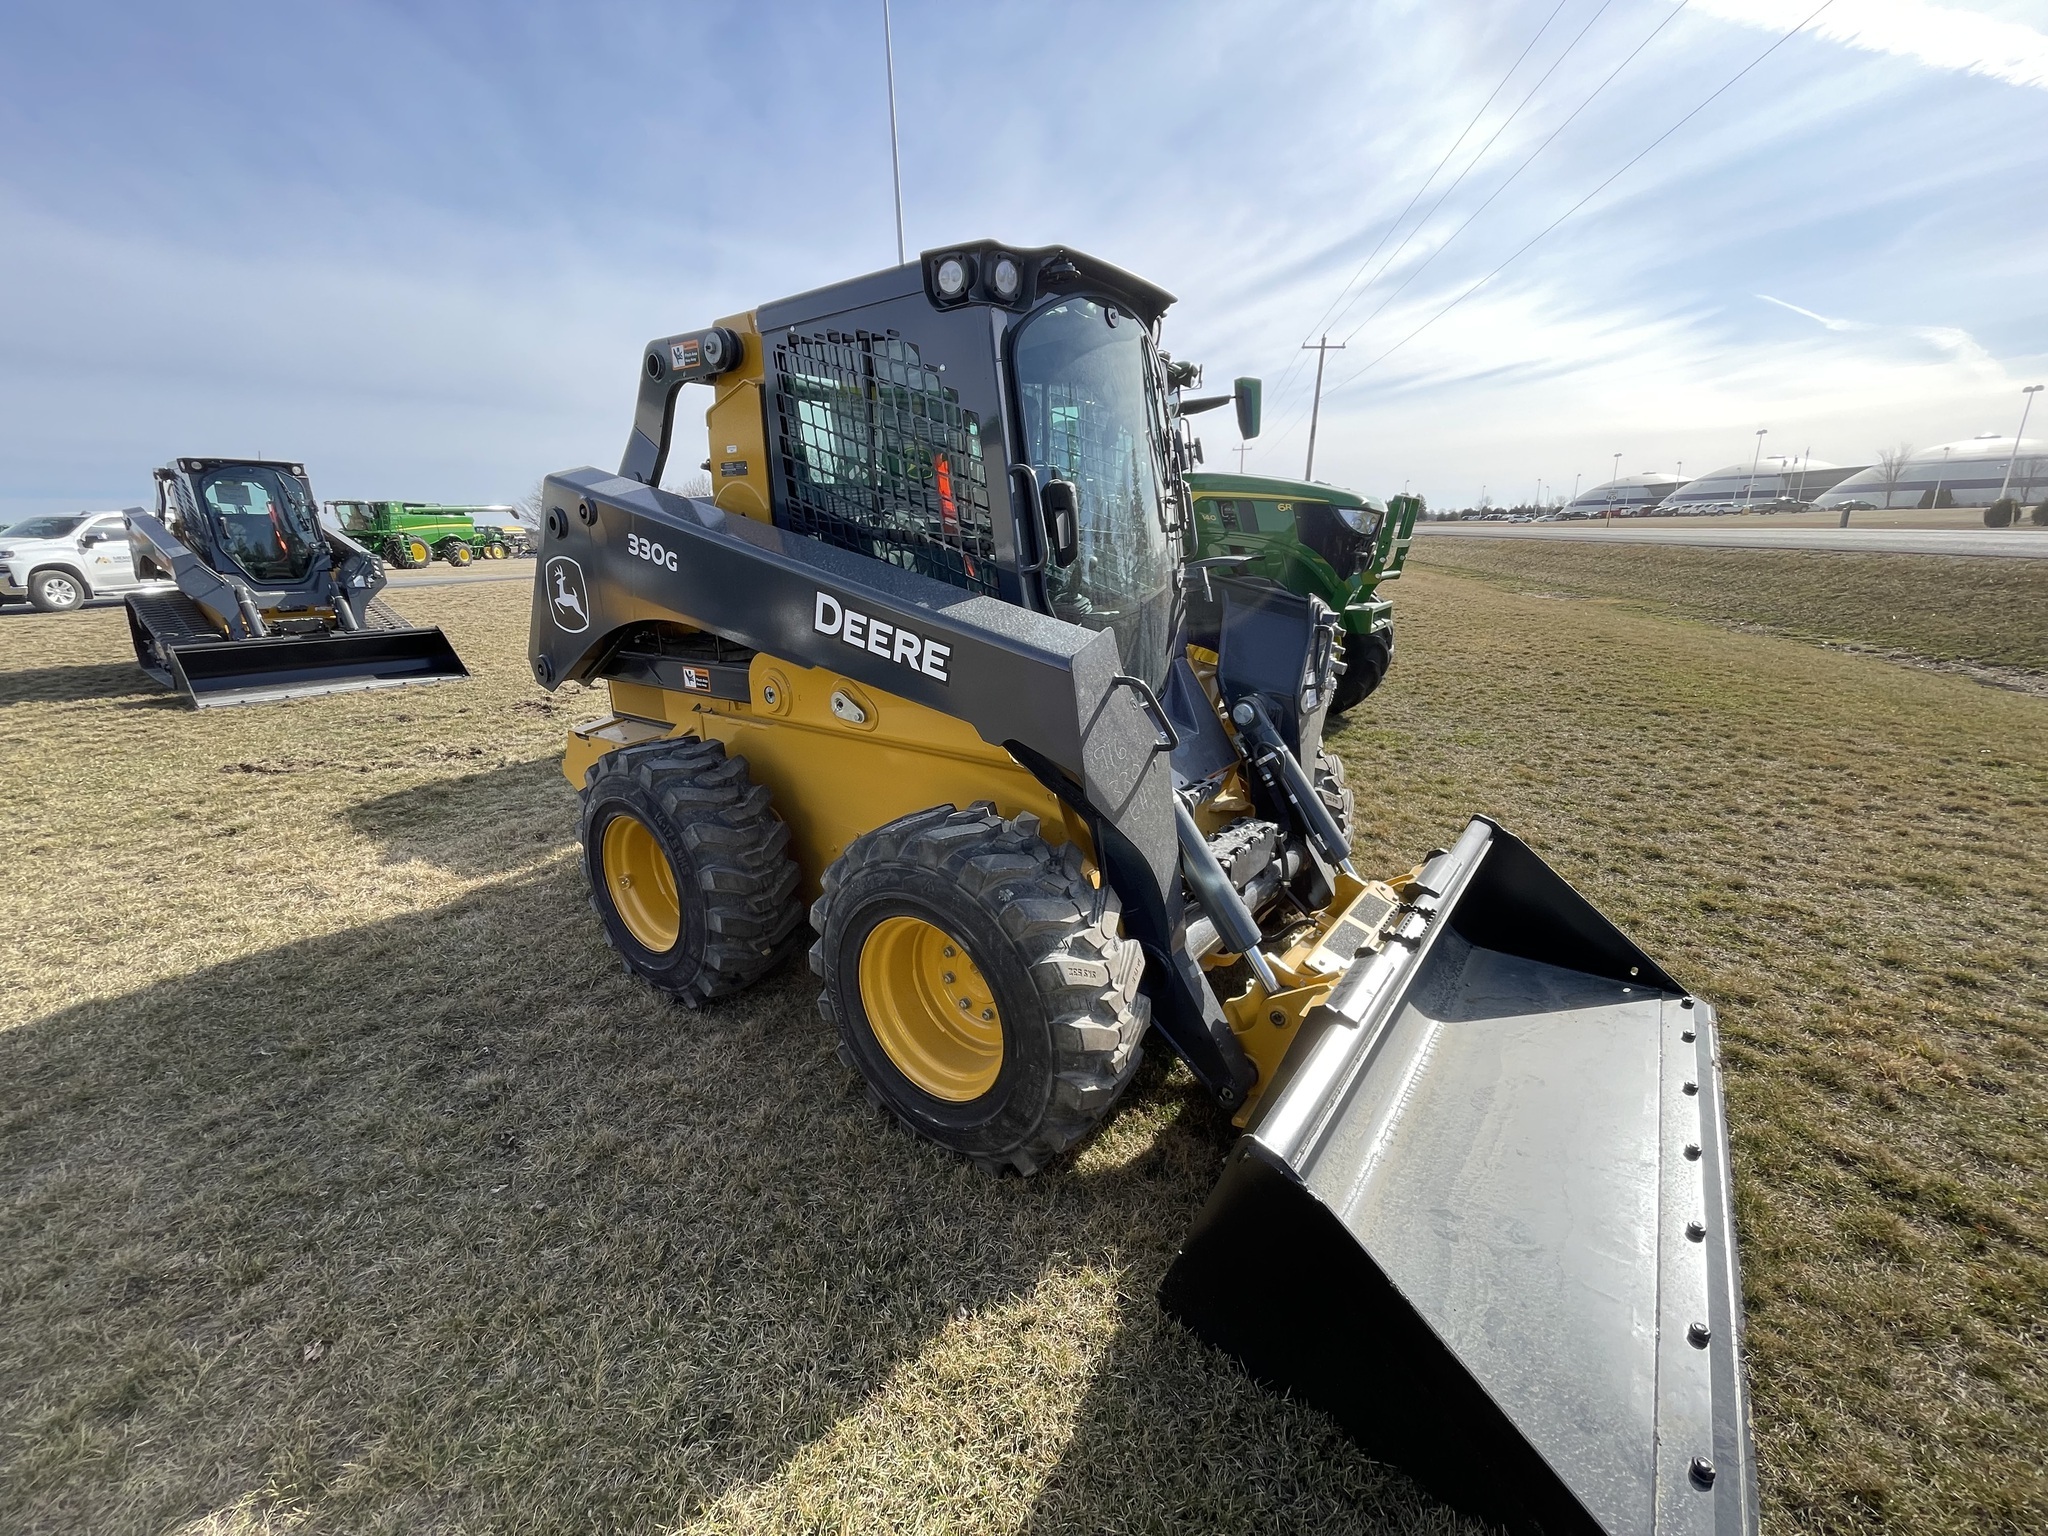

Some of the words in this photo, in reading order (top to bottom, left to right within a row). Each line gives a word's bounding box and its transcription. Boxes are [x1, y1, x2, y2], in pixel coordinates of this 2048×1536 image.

[1277, 503, 1293, 512] 6R
[627, 533, 678, 572] 330G
[814, 591, 951, 682] DEERE
